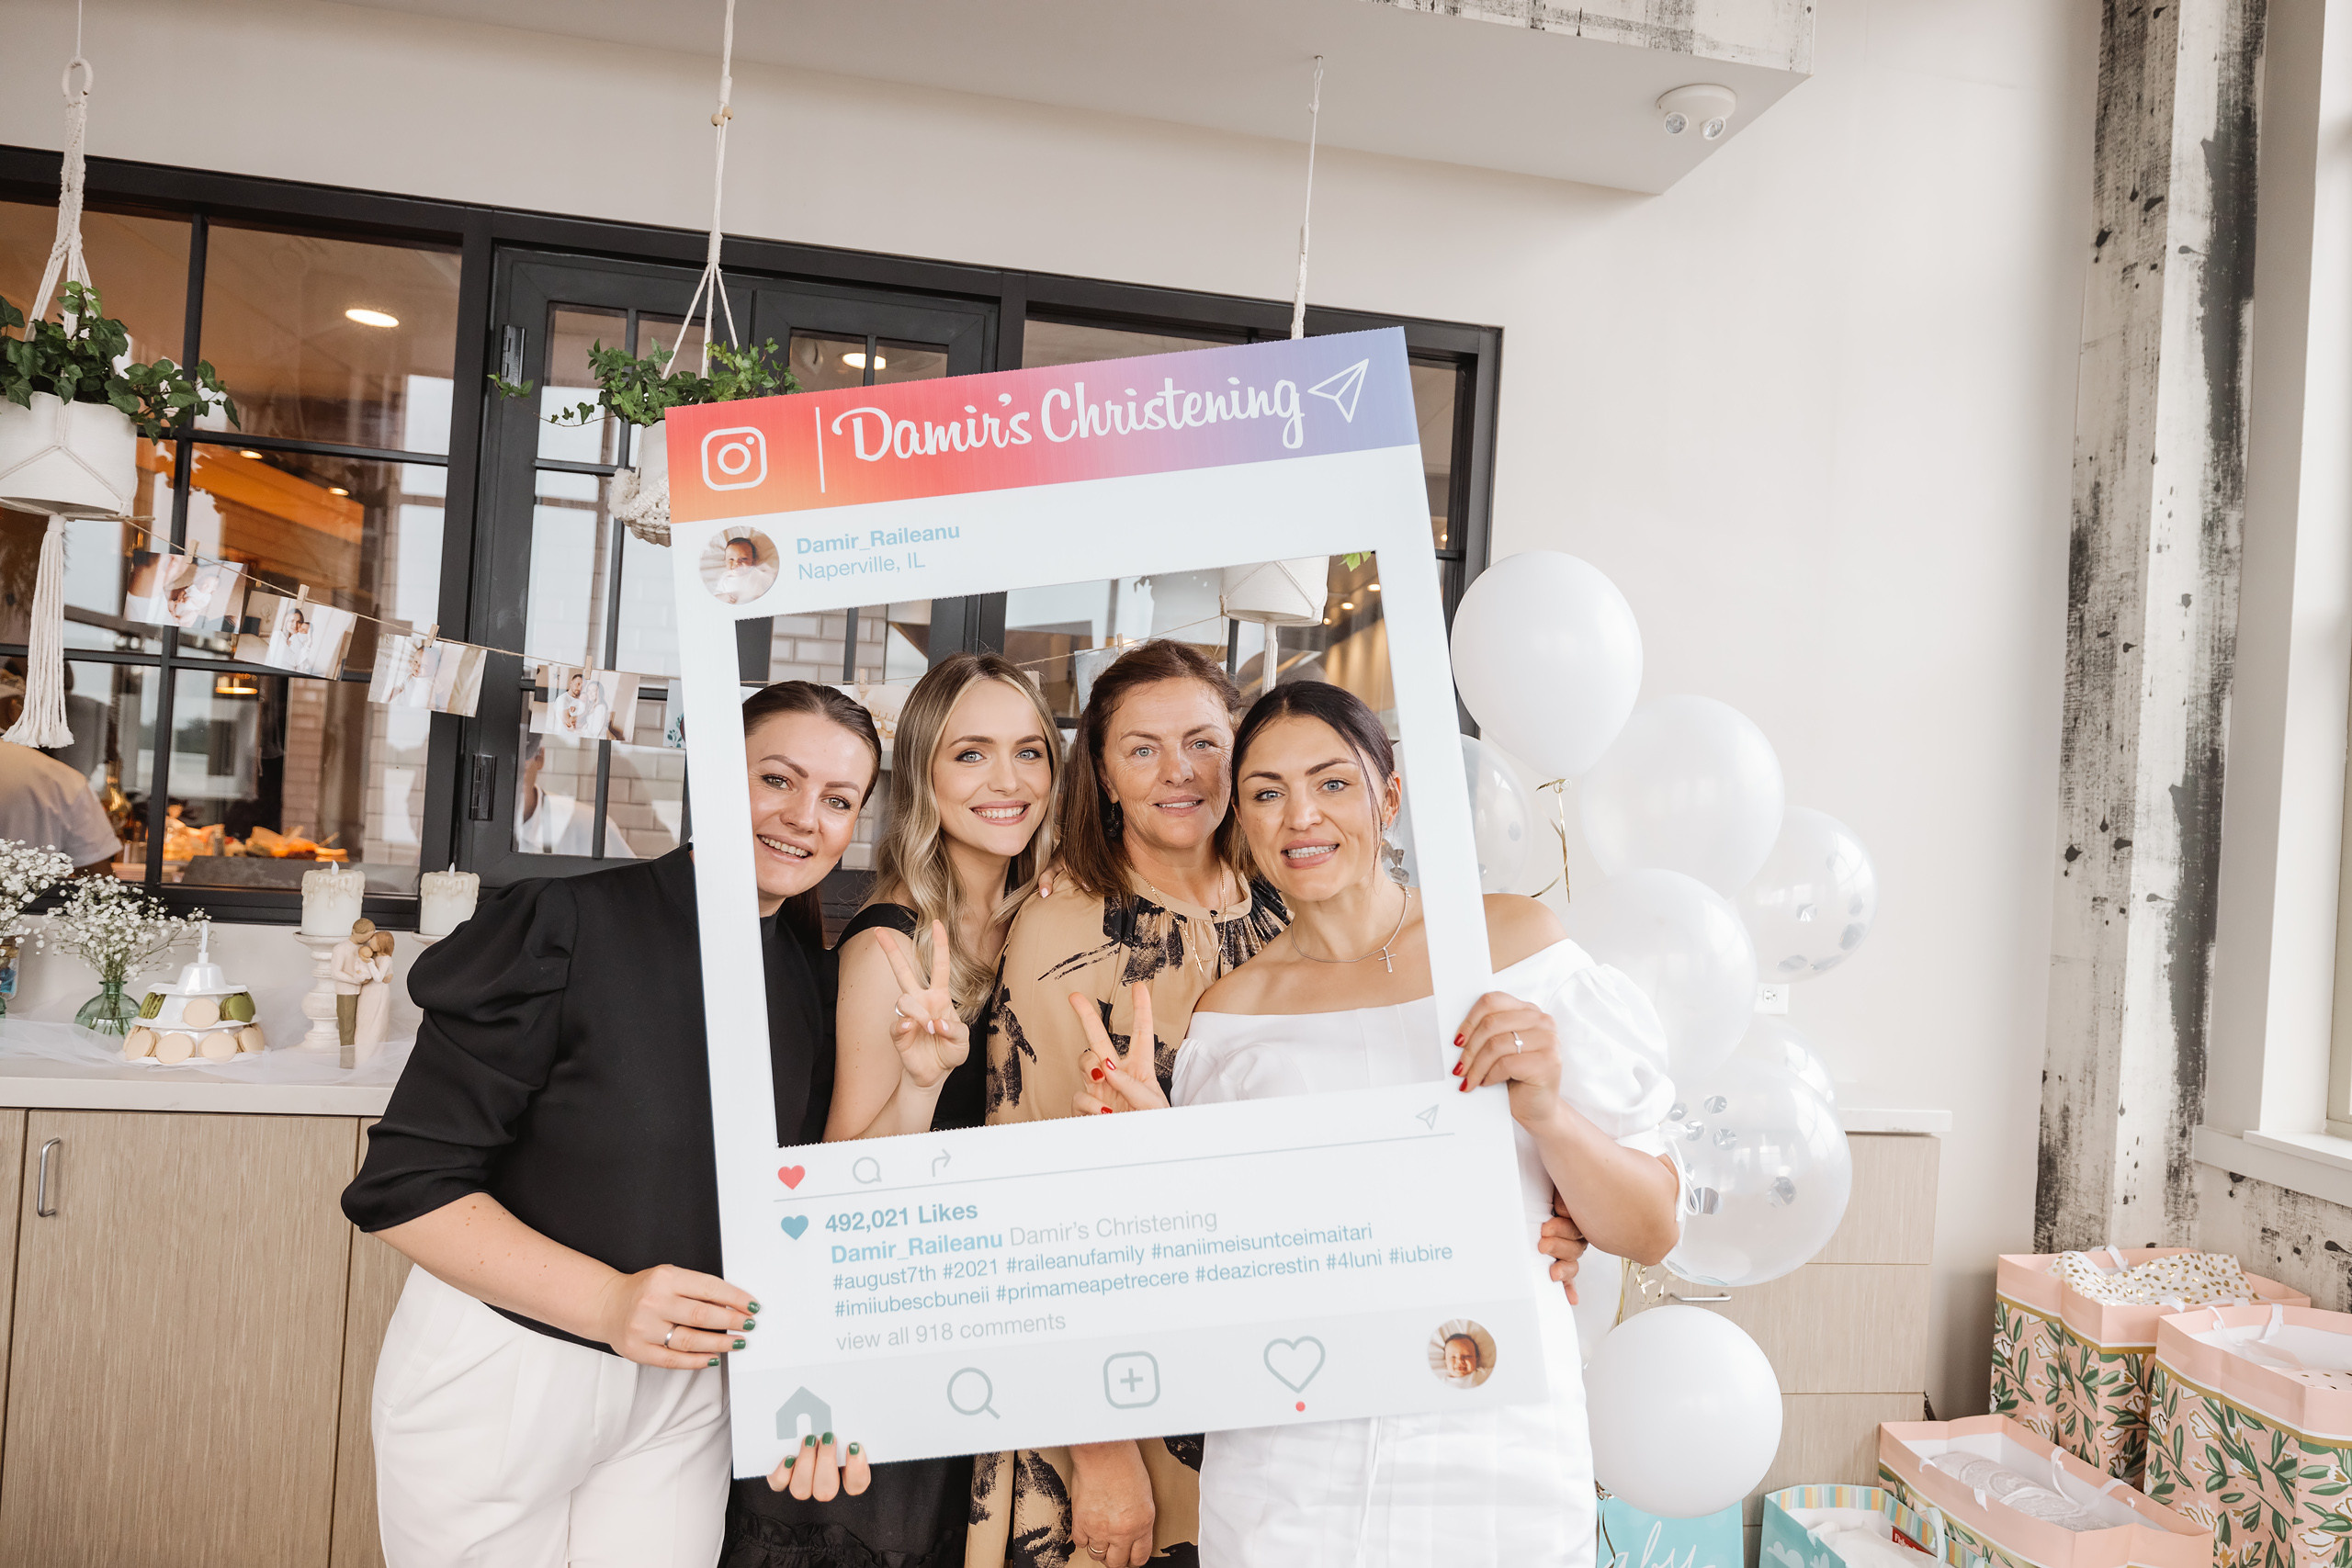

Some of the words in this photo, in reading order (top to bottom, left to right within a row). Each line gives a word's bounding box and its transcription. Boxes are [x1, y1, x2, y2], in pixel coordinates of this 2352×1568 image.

[831, 393, 1032, 461] Damir's
[1040, 377, 1305, 449] Christening
[797, 525, 960, 555] Damir_Raileanu
[798, 555, 900, 581] Naperville,
[908, 552, 926, 570] IL
[825, 1207, 909, 1233] 492,021
[918, 1202, 978, 1224] Likes
[831, 1233, 1003, 1264] Damir_Raileanu
[1010, 1221, 1090, 1247] Damir's
[1096, 1210, 1217, 1238] Christening
[832, 1265, 937, 1292] #august7th
[943, 1258, 999, 1280] #2021
[1006, 1244, 1145, 1273] #raileanufamily
[1151, 1222, 1373, 1259] #naniimeisuntceimaitari
[834, 1286, 990, 1317] #imiiubescbuneii
[995, 1269, 1189, 1304] #primameapetrecere
[1194, 1256, 1320, 1283] #deazicrestin
[1326, 1248, 1383, 1271] #4luni
[1388, 1244, 1453, 1265] #iubire
[836, 1331, 881, 1351] view
[888, 1326, 910, 1347] all
[915, 1322, 954, 1343] 918
[960, 1313, 1067, 1340] comments
